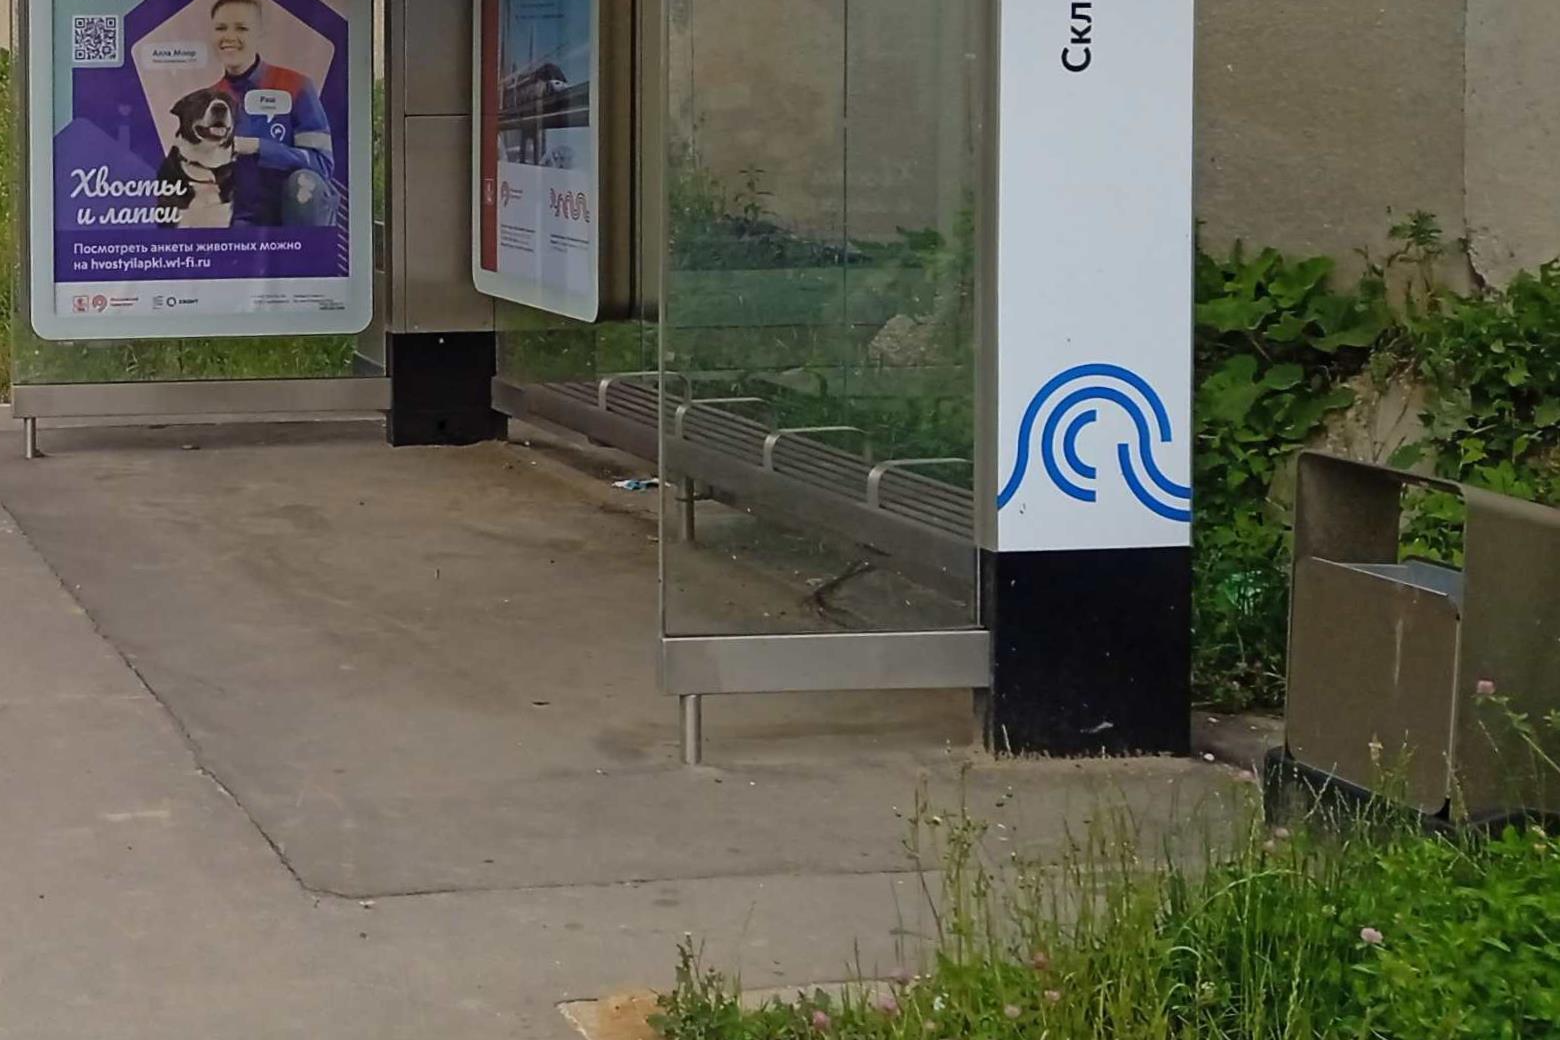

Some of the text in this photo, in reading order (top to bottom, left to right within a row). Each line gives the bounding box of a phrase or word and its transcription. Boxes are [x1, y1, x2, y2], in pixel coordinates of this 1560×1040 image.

[70, 165, 188, 198] Хвосты
[77, 206, 182, 225] и лапки
[73, 240, 302, 256] Посмотреть анкеты животных можно
[73, 261, 88, 271] на
